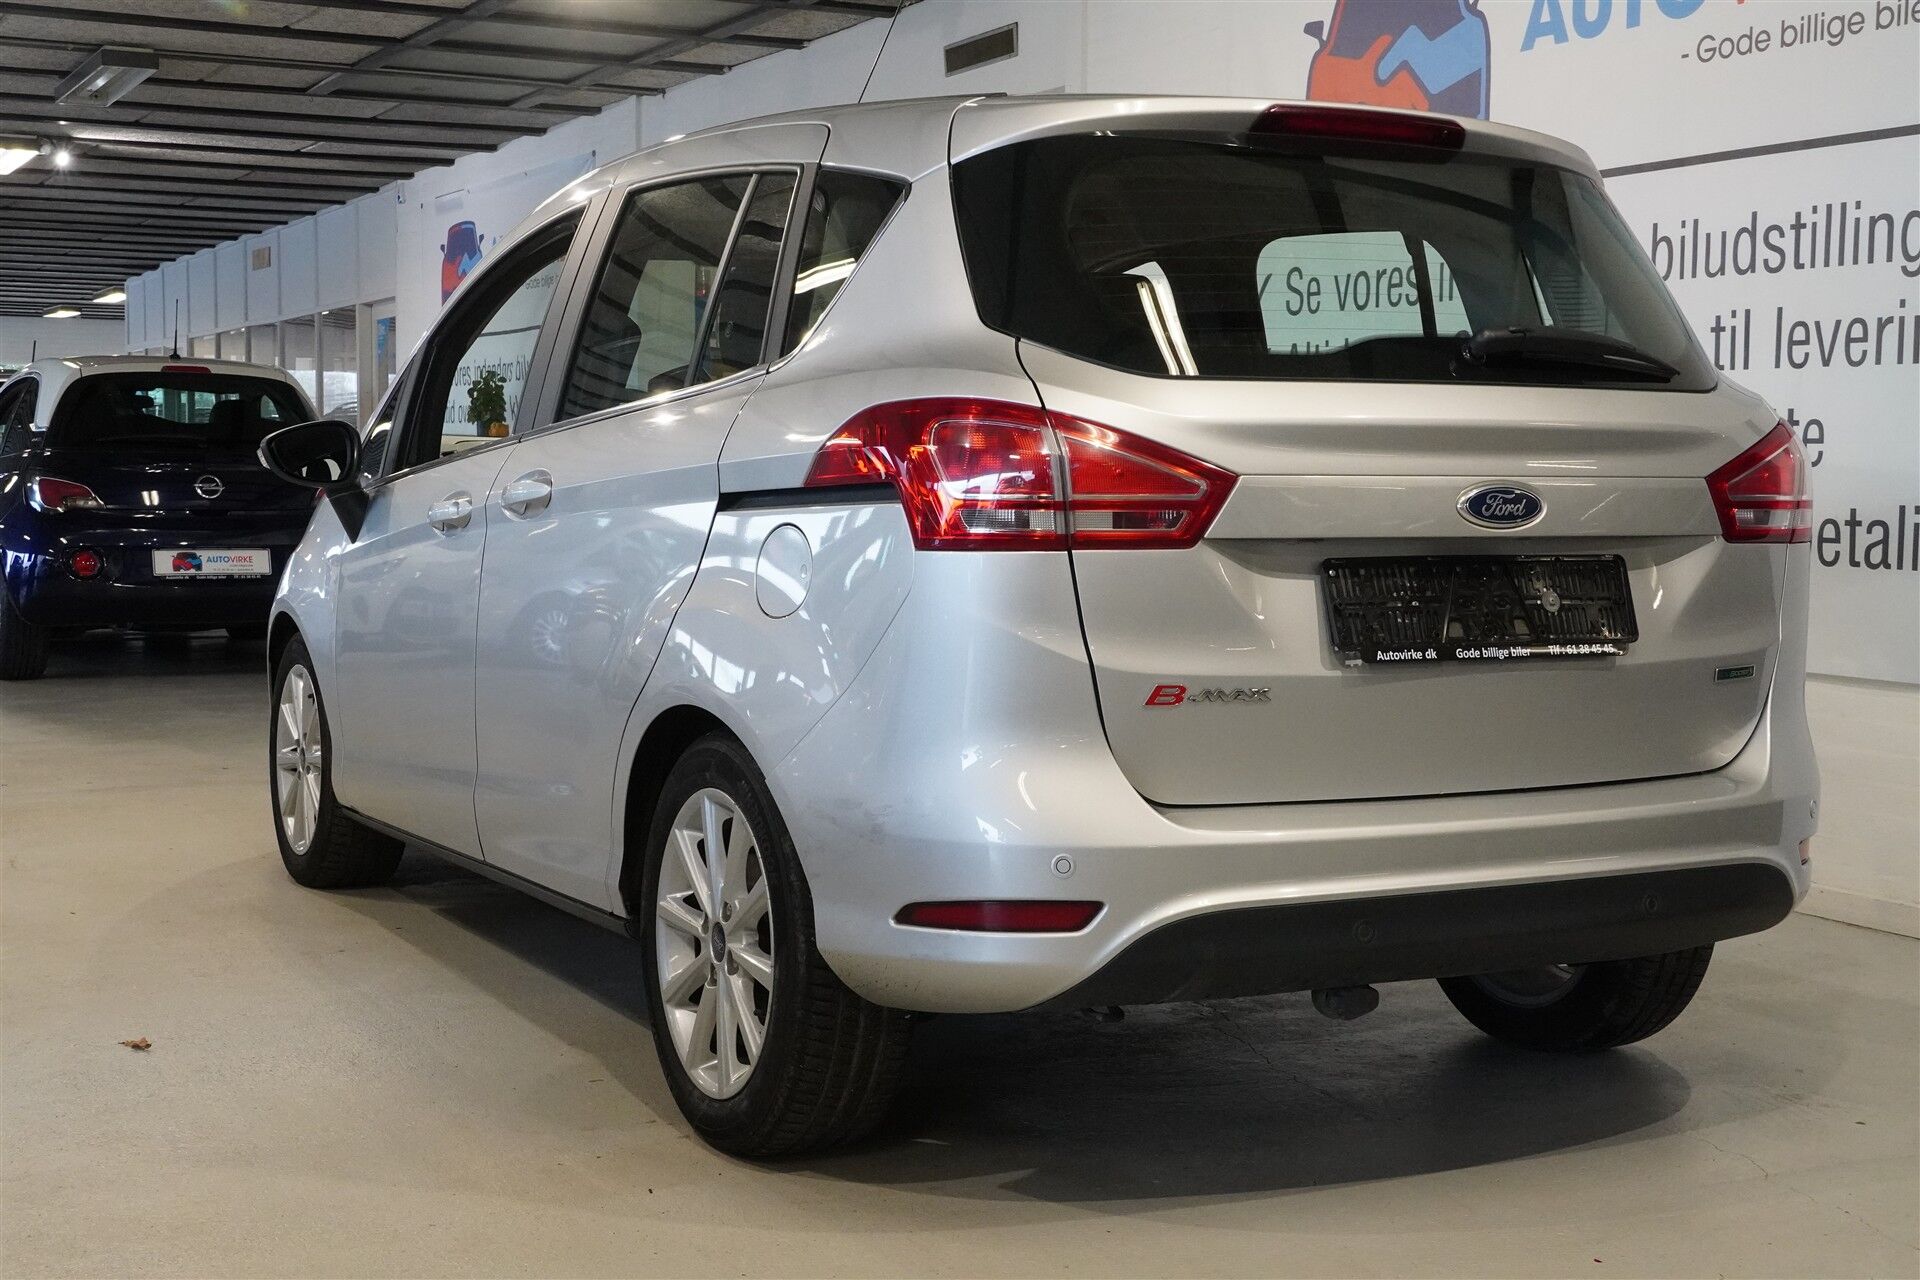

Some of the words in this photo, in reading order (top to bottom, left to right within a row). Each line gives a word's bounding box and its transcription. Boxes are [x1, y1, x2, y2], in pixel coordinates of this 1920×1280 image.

[1696, 27, 1771, 63] Gode
[1780, 12, 1866, 48] billige
[1285, 266, 1322, 317] Se
[1333, 265, 1420, 312] vores
[1651, 200, 1920, 282] biludstilling
[1710, 308, 1752, 371] til
[1774, 298, 1920, 370] leveri
[1481, 492, 1527, 517] Ford
[206, 555, 254, 564] AUTOVIRKE
[1376, 649, 1423, 661] Autovirke
[1425, 648, 1438, 659] dk
[1455, 648, 1481, 659] Gode
[1482, 647, 1509, 660] billige
[1510, 646, 1531, 657] biler
